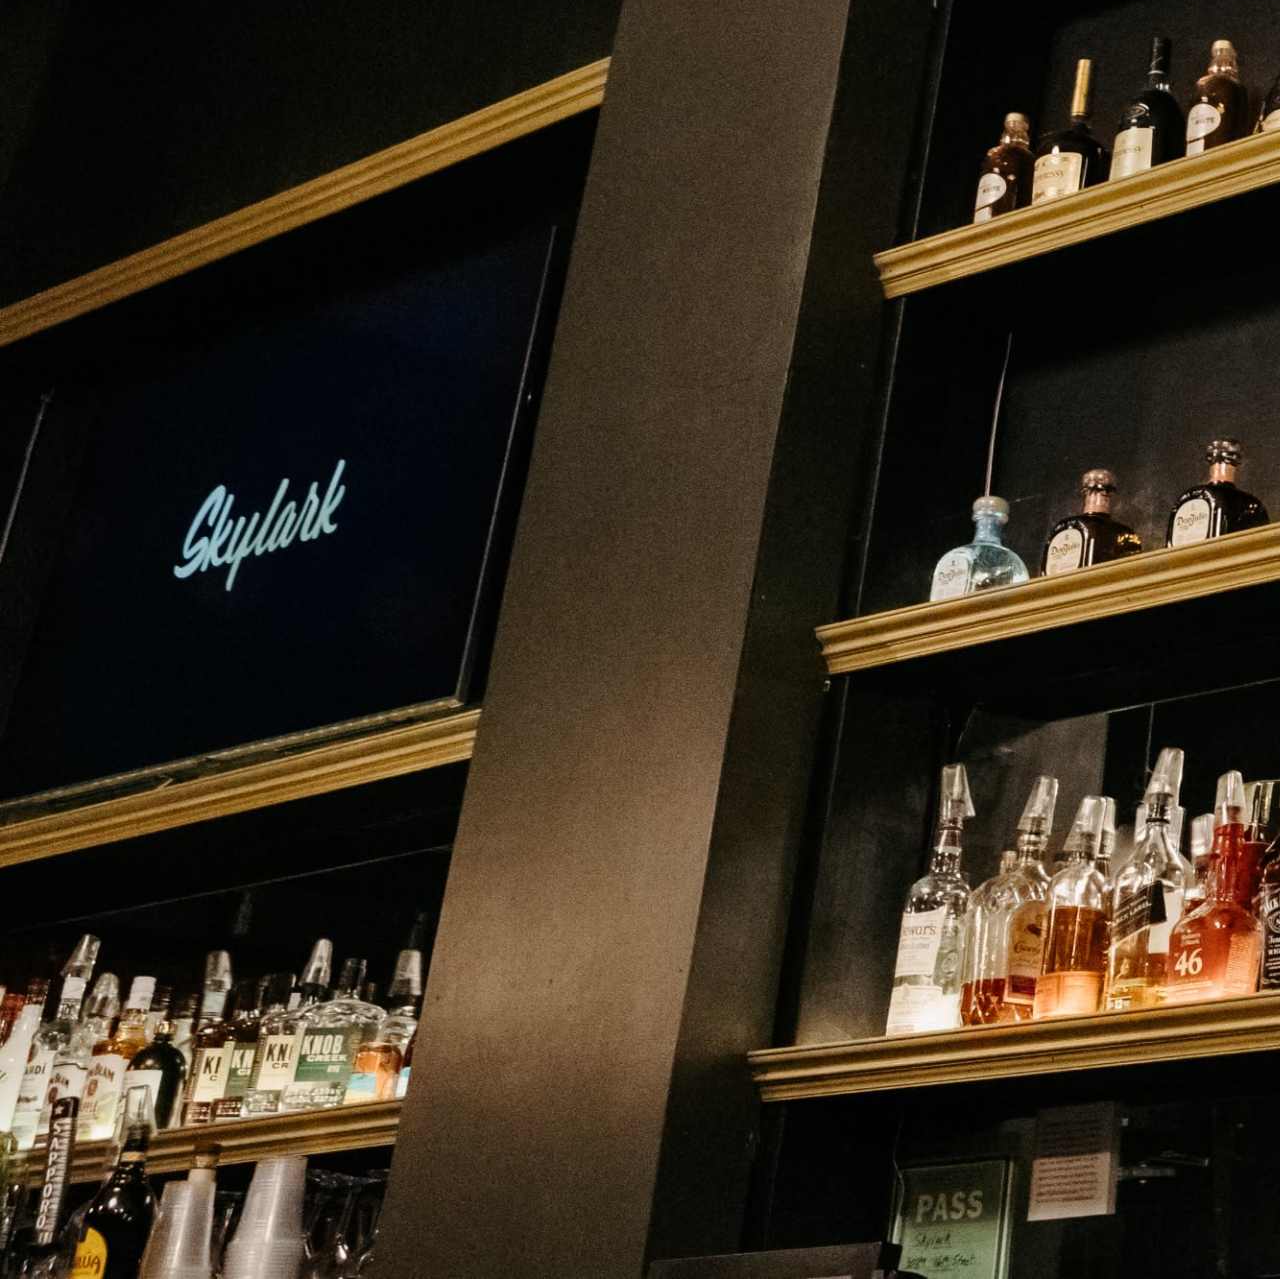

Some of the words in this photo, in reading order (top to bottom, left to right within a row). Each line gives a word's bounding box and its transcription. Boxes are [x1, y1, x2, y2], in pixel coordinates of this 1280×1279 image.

[173, 458, 346, 592] Skylark
[1174, 947, 1203, 977] 46
[301, 1034, 344, 1055] KNOB
[305, 1053, 348, 1063] CREEK
[36, 1120, 63, 1230] SAPPORO
[915, 1189, 984, 1223] PASS
